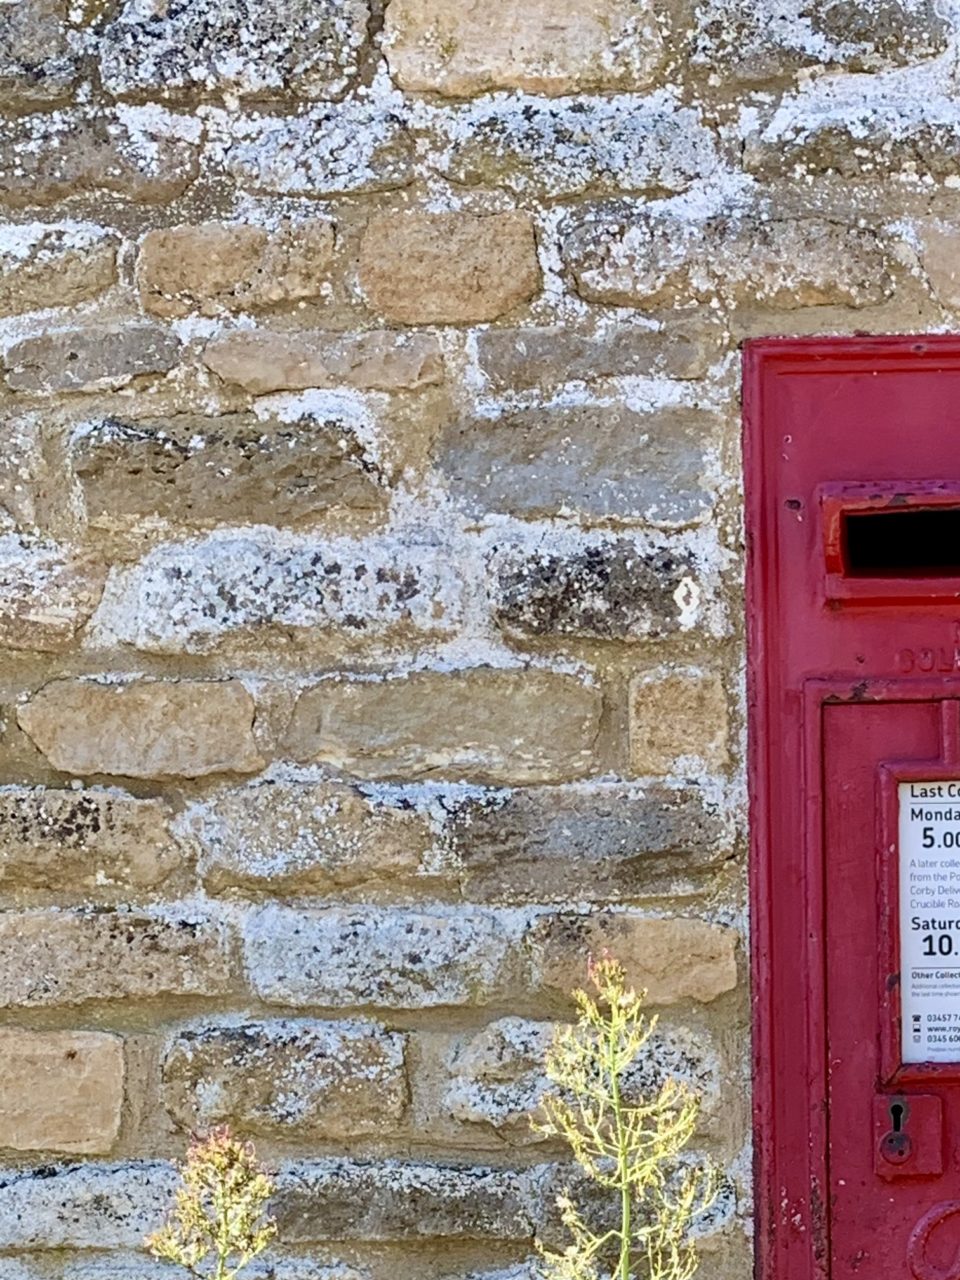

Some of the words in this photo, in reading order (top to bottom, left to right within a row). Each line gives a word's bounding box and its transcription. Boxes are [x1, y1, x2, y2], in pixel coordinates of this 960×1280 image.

[910, 784, 943, 798] Last
[909, 859, 917, 868] A
[918, 859, 938, 868] later
[909, 873, 931, 882] from
[933, 873, 947, 882] the
[910, 886, 936, 896] Corby
[910, 899, 946, 909] Crucible
[911, 971, 933, 979] Other
[927, 1014, 951, 1022] 03457
[927, 1034, 947, 1043] 0345
